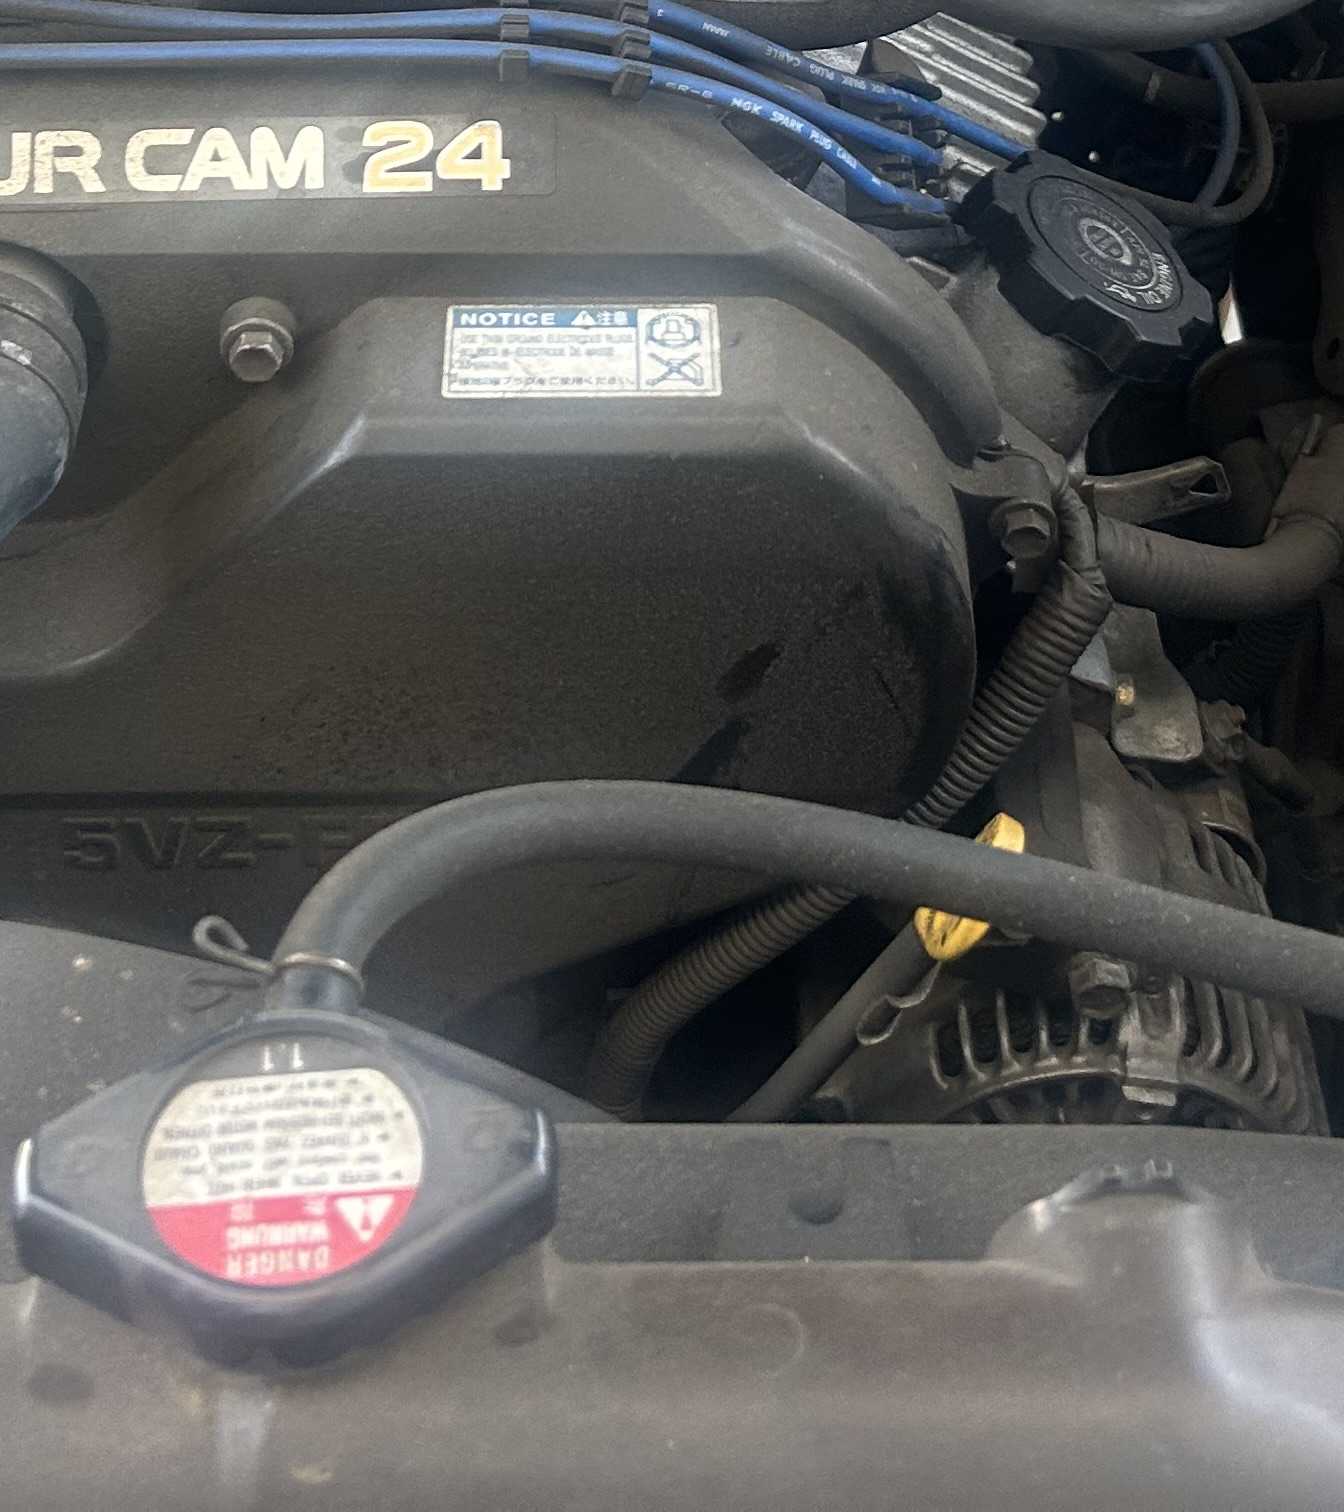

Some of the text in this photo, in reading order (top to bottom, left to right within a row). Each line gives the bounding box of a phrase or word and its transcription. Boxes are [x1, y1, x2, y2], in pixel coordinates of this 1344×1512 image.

[765, 44, 804, 69] CABLE
[809, 62, 836, 83] PLUG
[730, 96, 763, 116] NGK
[770, 110, 806, 134] SPARK
[125, 120, 324, 196] CAM
[362, 119, 512, 193] 24
[459, 311, 556, 327] NOTICE
[61, 814, 394, 871] 5VZ-F
[225, 1246, 329, 1279] DANGER
